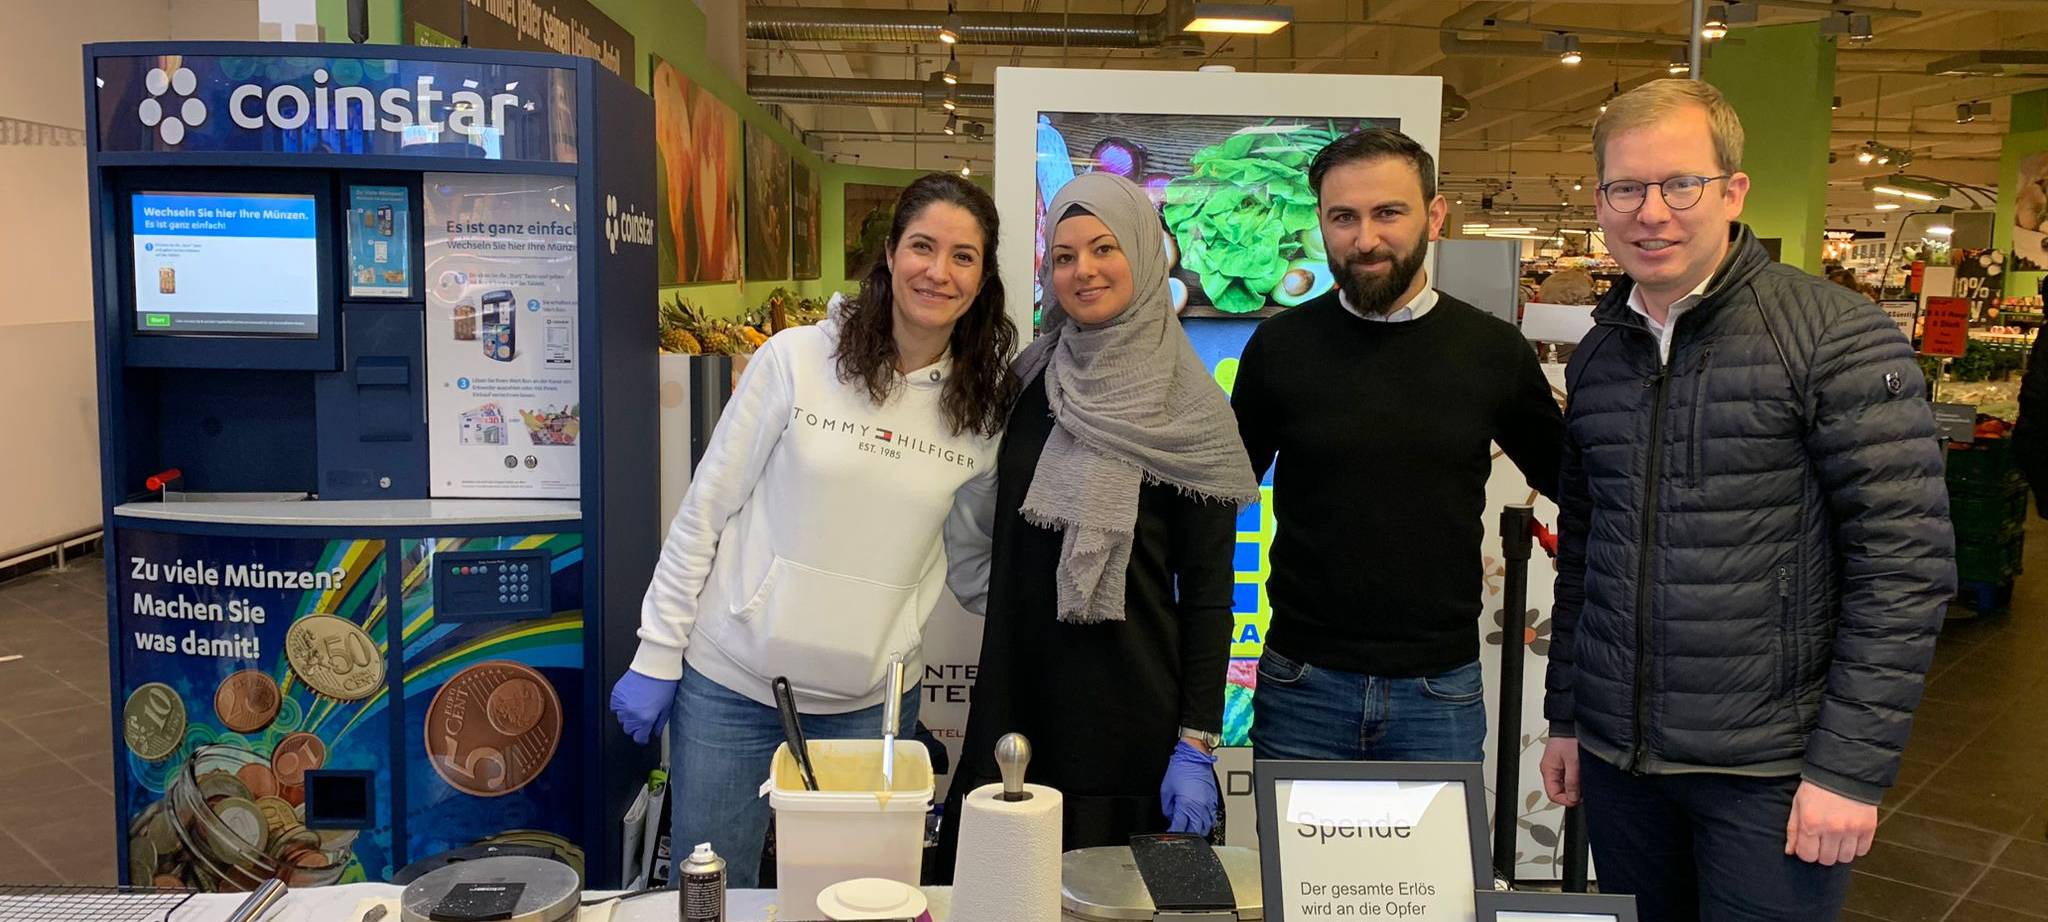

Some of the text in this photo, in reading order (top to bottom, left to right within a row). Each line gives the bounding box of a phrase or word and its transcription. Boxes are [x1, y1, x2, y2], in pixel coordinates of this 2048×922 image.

[229, 68, 518, 136] coinstar
[144, 207, 308, 221] Wechseln Sie hier Ihre Münzen.
[145, 220, 226, 231] Es ist ganz einfach!
[447, 221, 462, 233] Es
[467, 220, 485, 234] ist
[488, 225, 524, 238] ganz
[621, 204, 654, 245] coinstar
[447, 242, 492, 250] Wechseln
[493, 242, 506, 250] Sie
[508, 242, 525, 250] hier
[527, 243, 546, 251] Ihre
[1955, 277, 1989, 299] 0%
[793, 406, 975, 469] TOMMY HILFIGER
[859, 442, 901, 460] EST. 1985
[131, 557, 346, 590] Zu viele Münzen?
[133, 593, 265, 624] Machen Sie
[134, 629, 260, 659] was damit!
[324, 632, 371, 675] 50
[144, 688, 171, 730] 10
[445, 689, 469, 735] CENT
[445, 736, 506, 788] 5
[1297, 811, 1411, 844] Spende
[1300, 881, 1436, 900] Der gesamte Erlös
[1301, 901, 1426, 919] wird an die Opfer
